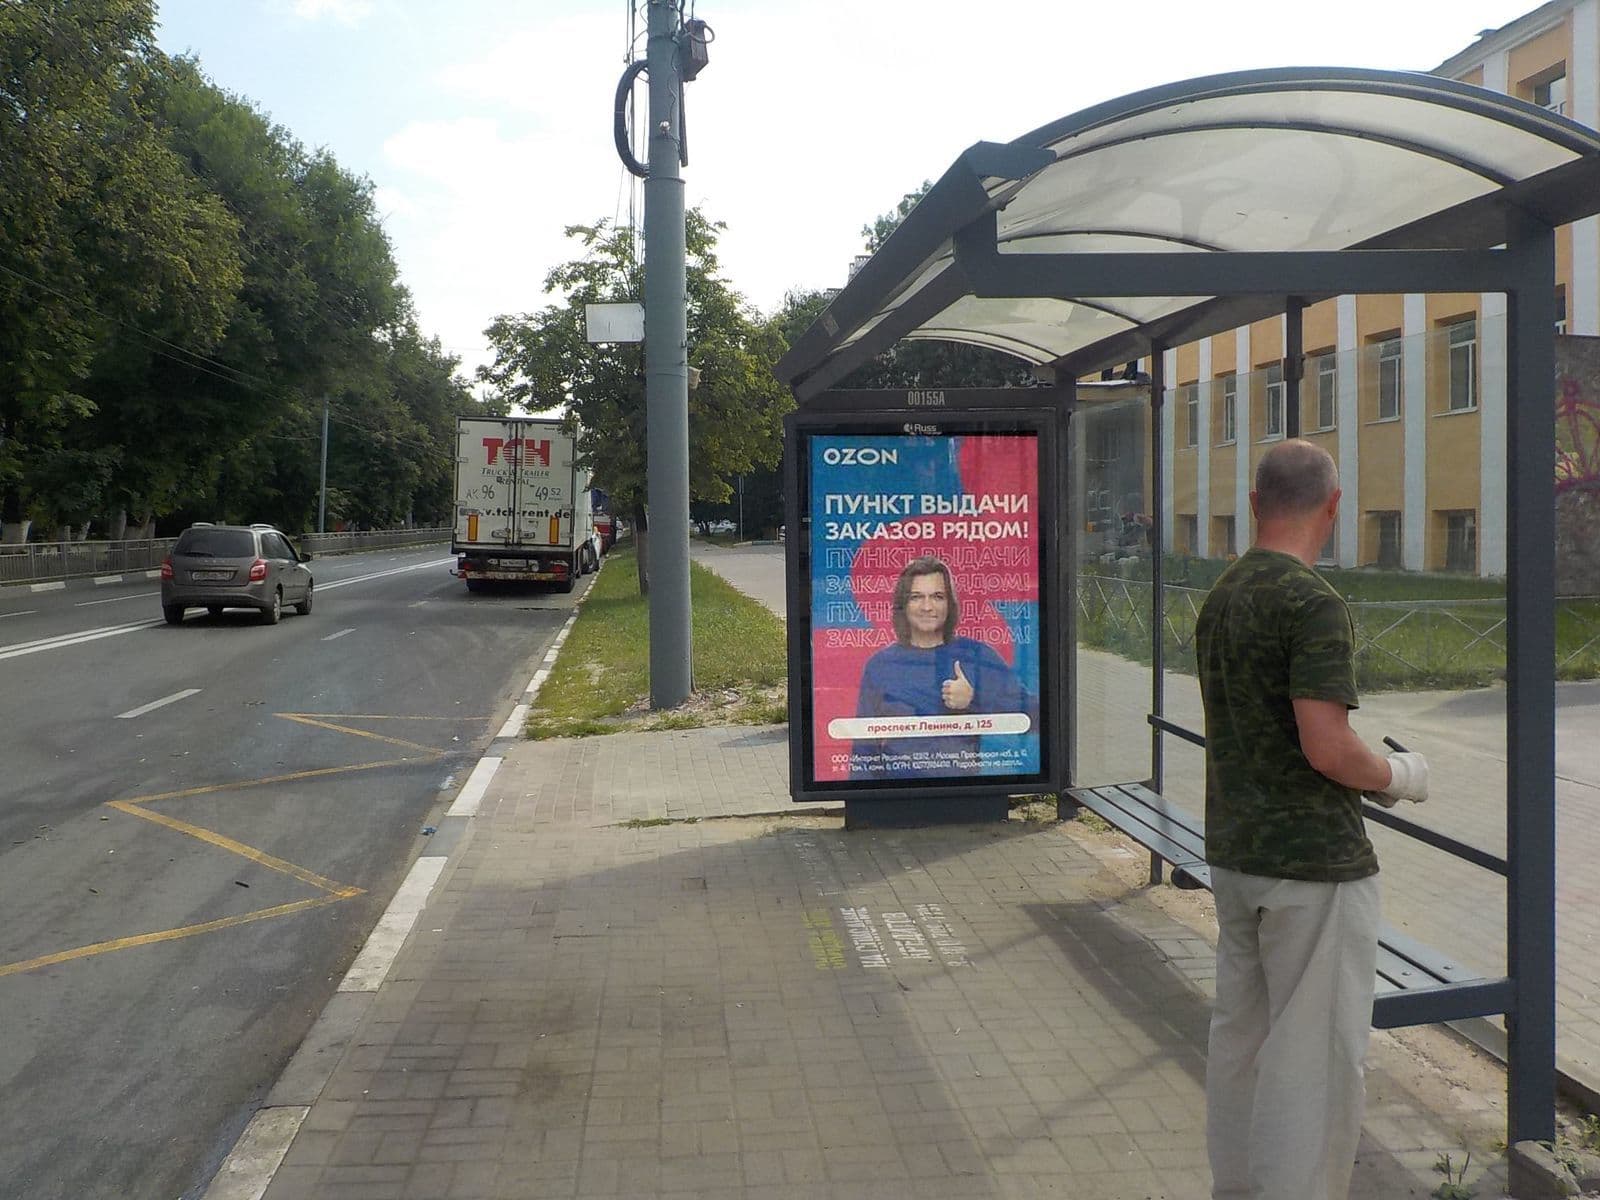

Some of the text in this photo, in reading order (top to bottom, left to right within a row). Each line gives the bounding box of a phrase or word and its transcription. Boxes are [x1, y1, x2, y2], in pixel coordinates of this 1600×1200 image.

[823, 447, 898, 465] OZON
[824, 494, 1029, 517] ПУНКТ ВЫДАЧИ
[825, 521, 1029, 542] ЗАКАЗОВ РЯДОМ!
[825, 547, 916, 569] ПУНКТ
[953, 573, 1030, 596] ЯДОМ!
[867, 719, 993, 734] проспект Ленина, д. 125
